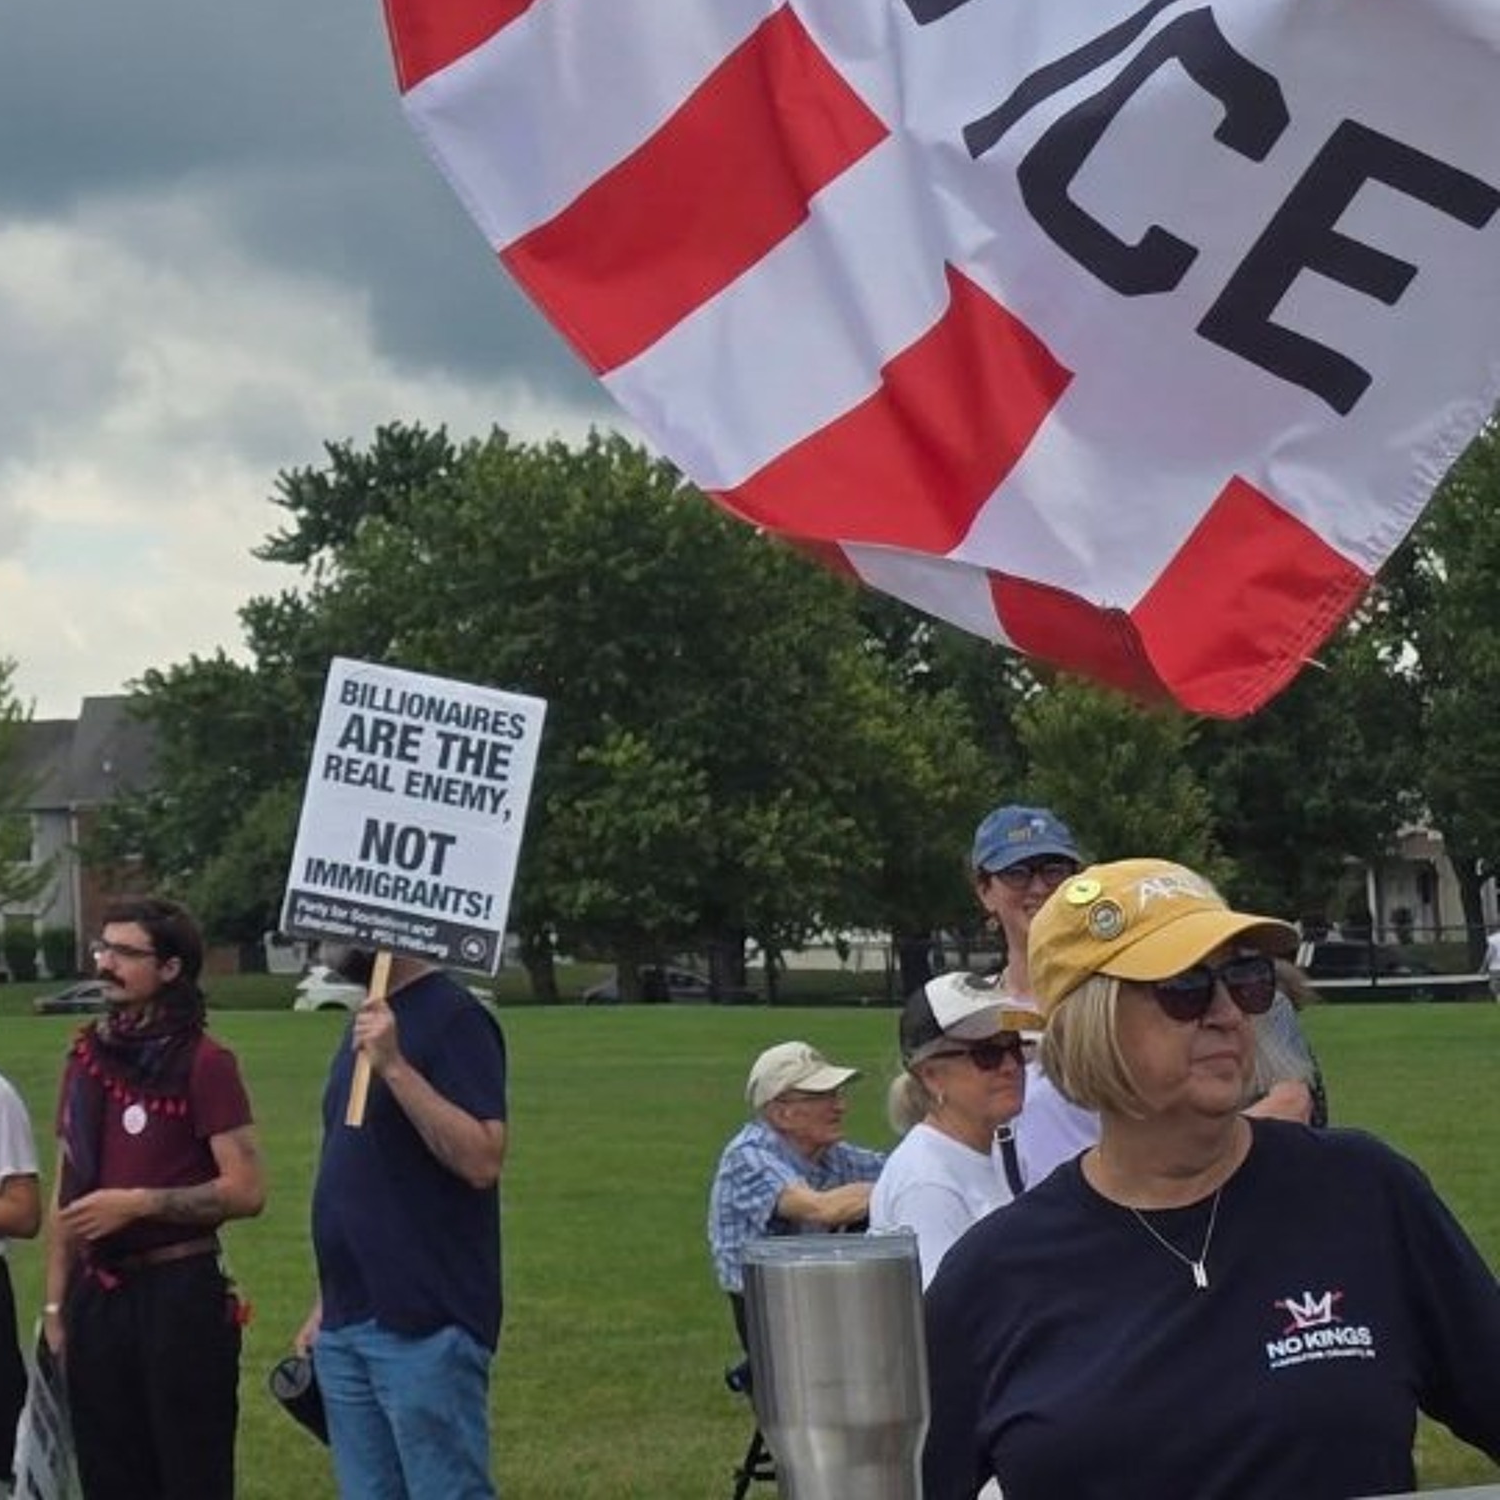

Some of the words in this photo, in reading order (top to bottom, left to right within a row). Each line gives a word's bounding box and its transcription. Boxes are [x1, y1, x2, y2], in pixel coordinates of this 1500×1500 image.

[340, 679, 526, 740] BILLIONAIRES
[337, 713, 423, 764] ARE
[436, 730, 513, 781] THE
[322, 754, 395, 793] REAL
[404, 771, 512, 824] ENEMY,
[358, 818, 456, 876] NOT
[303, 857, 493, 920] IMMIGRANTS!
[1265, 1336, 1303, 1359] NO
[1304, 1326, 1373, 1350] KINGS
